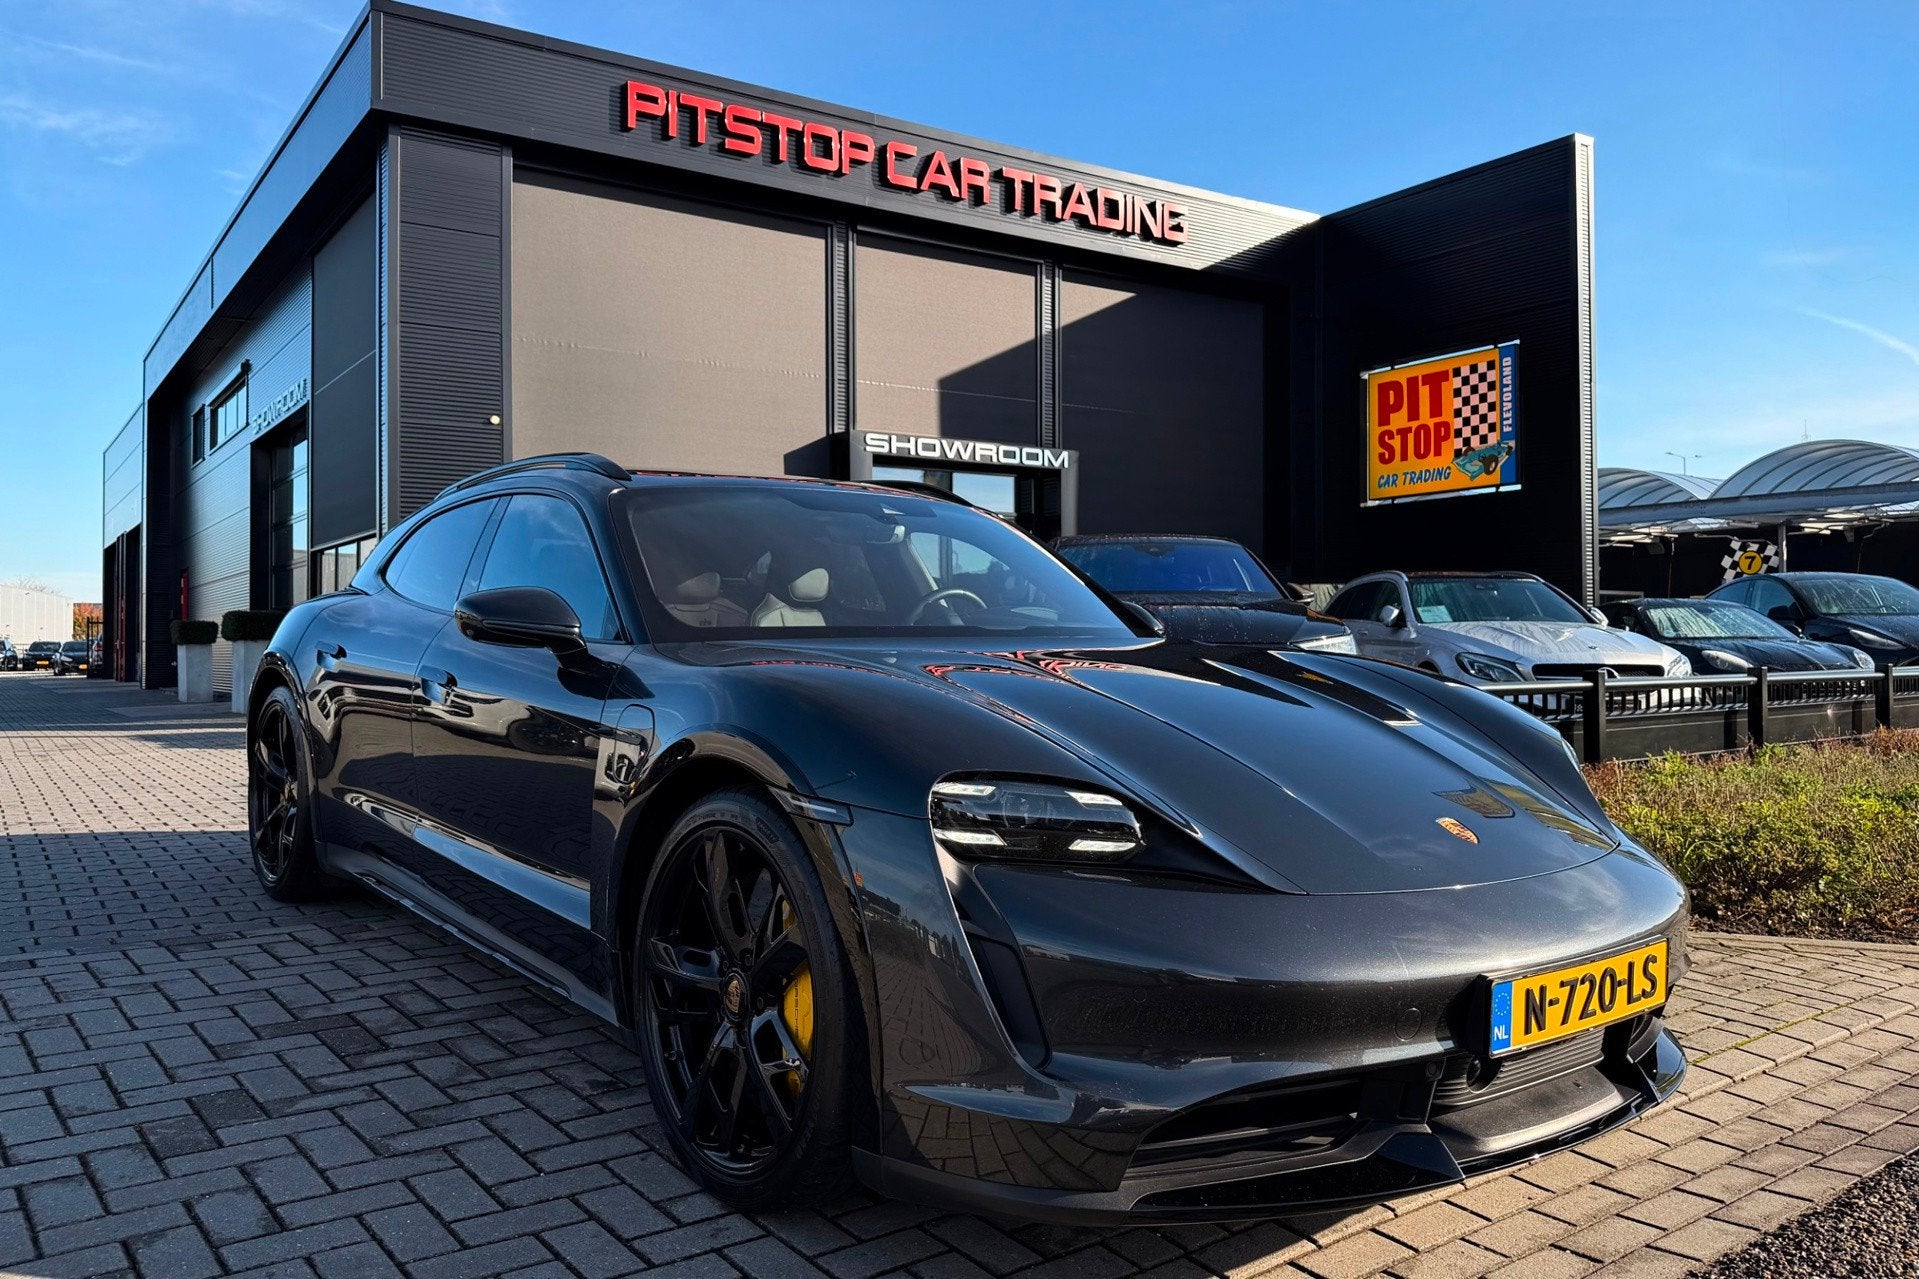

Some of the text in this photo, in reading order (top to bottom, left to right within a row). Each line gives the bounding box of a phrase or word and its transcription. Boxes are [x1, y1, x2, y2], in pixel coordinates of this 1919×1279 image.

[626, 80, 1189, 245] PITSTOP CAR TRADING
[1377, 369, 1449, 427] PIT
[1502, 356, 1512, 432] FLEVOLAND
[865, 432, 1068, 468] SHOWROOM
[1377, 420, 1451, 465] STOP
[1377, 465, 1452, 489] CAR TRADING
[1744, 555, 1757, 570] 7
[1524, 954, 1658, 1036] N-720-LS
[1494, 1025, 1508, 1040] NL
